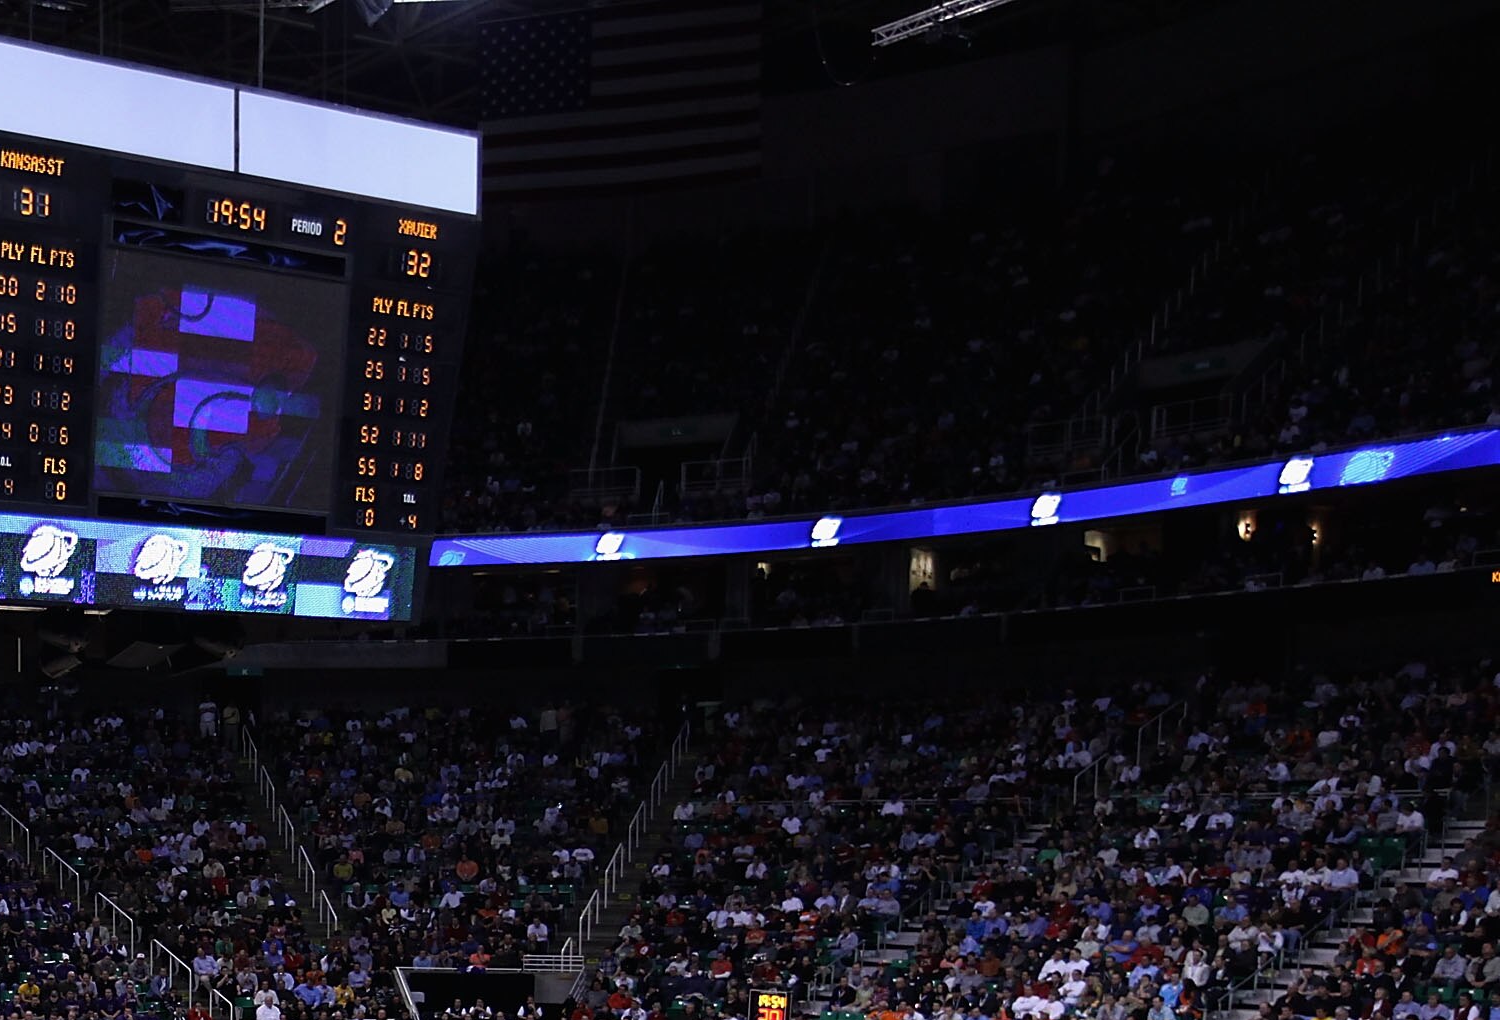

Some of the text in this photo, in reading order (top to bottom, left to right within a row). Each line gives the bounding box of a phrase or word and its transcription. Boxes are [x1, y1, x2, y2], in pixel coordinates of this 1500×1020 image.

[21, 186, 50, 216] 31
[213, 200, 347, 245] 19:54 PERIOD 2
[398, 219, 437, 239] XAVIER
[1, 241, 74, 268] PLY FL PTS
[407, 250, 431, 278] 32
[36, 281, 45, 301] 2
[60, 285, 76, 305] 10
[373, 297, 434, 320] PLY FL PTS
[65, 320, 75, 340] 0
[368, 327, 387, 347] 22
[64, 357, 73, 374] 4
[365, 360, 384, 380] 25
[61, 391, 71, 411] 2
[29, 423, 39, 442] 0
[361, 425, 379, 444] 52
[44, 458, 66, 475] FLS
[358, 457, 376, 476] 55
[56, 481, 66, 500] 0
[356, 487, 375, 502] FLS
[365, 508, 374, 526] 0
